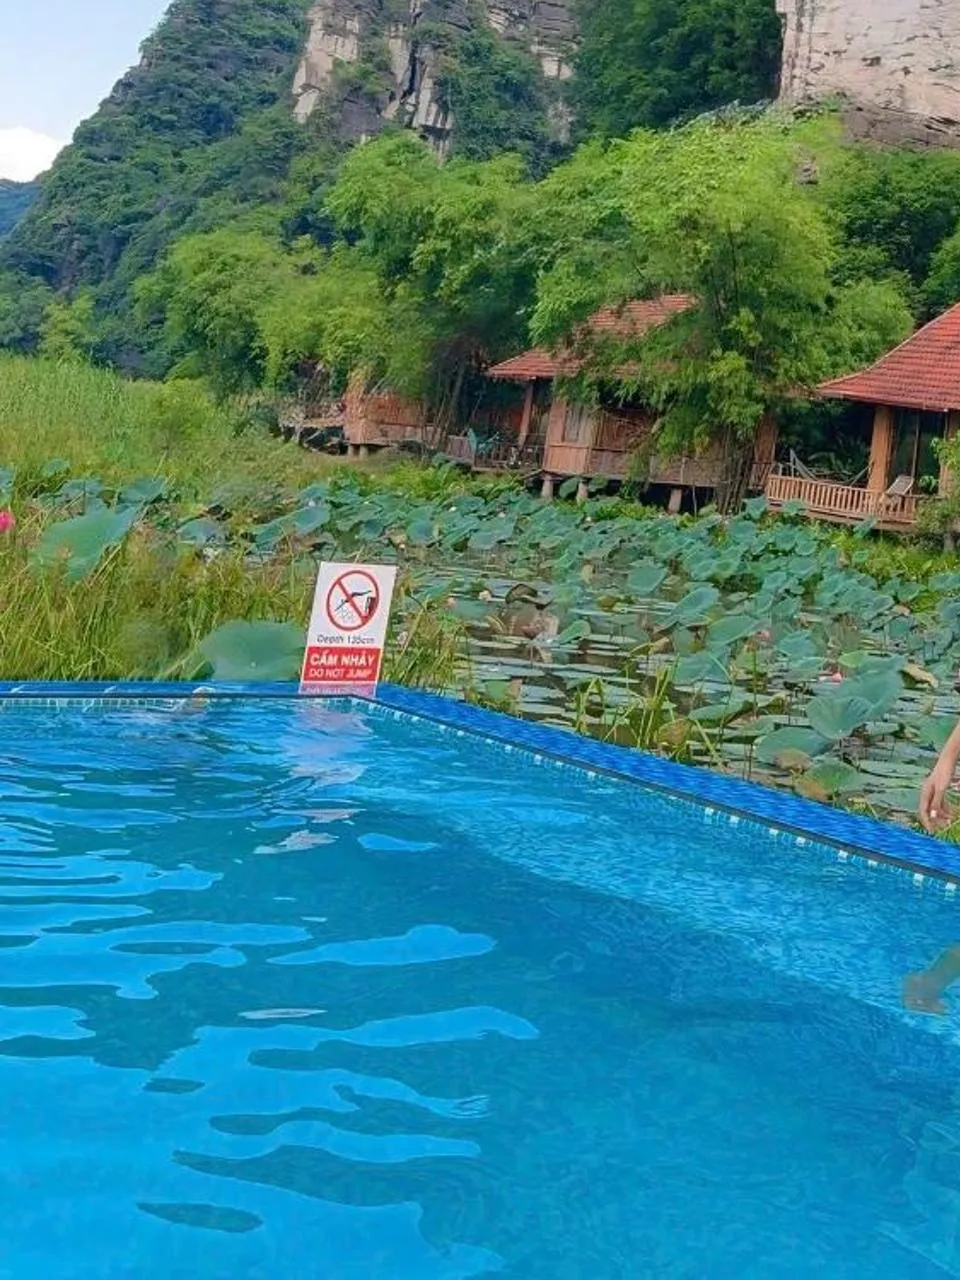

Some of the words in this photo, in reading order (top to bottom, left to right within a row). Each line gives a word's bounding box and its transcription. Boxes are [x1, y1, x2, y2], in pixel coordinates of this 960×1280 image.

[316, 633, 344, 645] Depth
[309, 668, 324, 678] DO
[325, 668, 345, 678] NOT
[345, 668, 373, 678] JUMP
